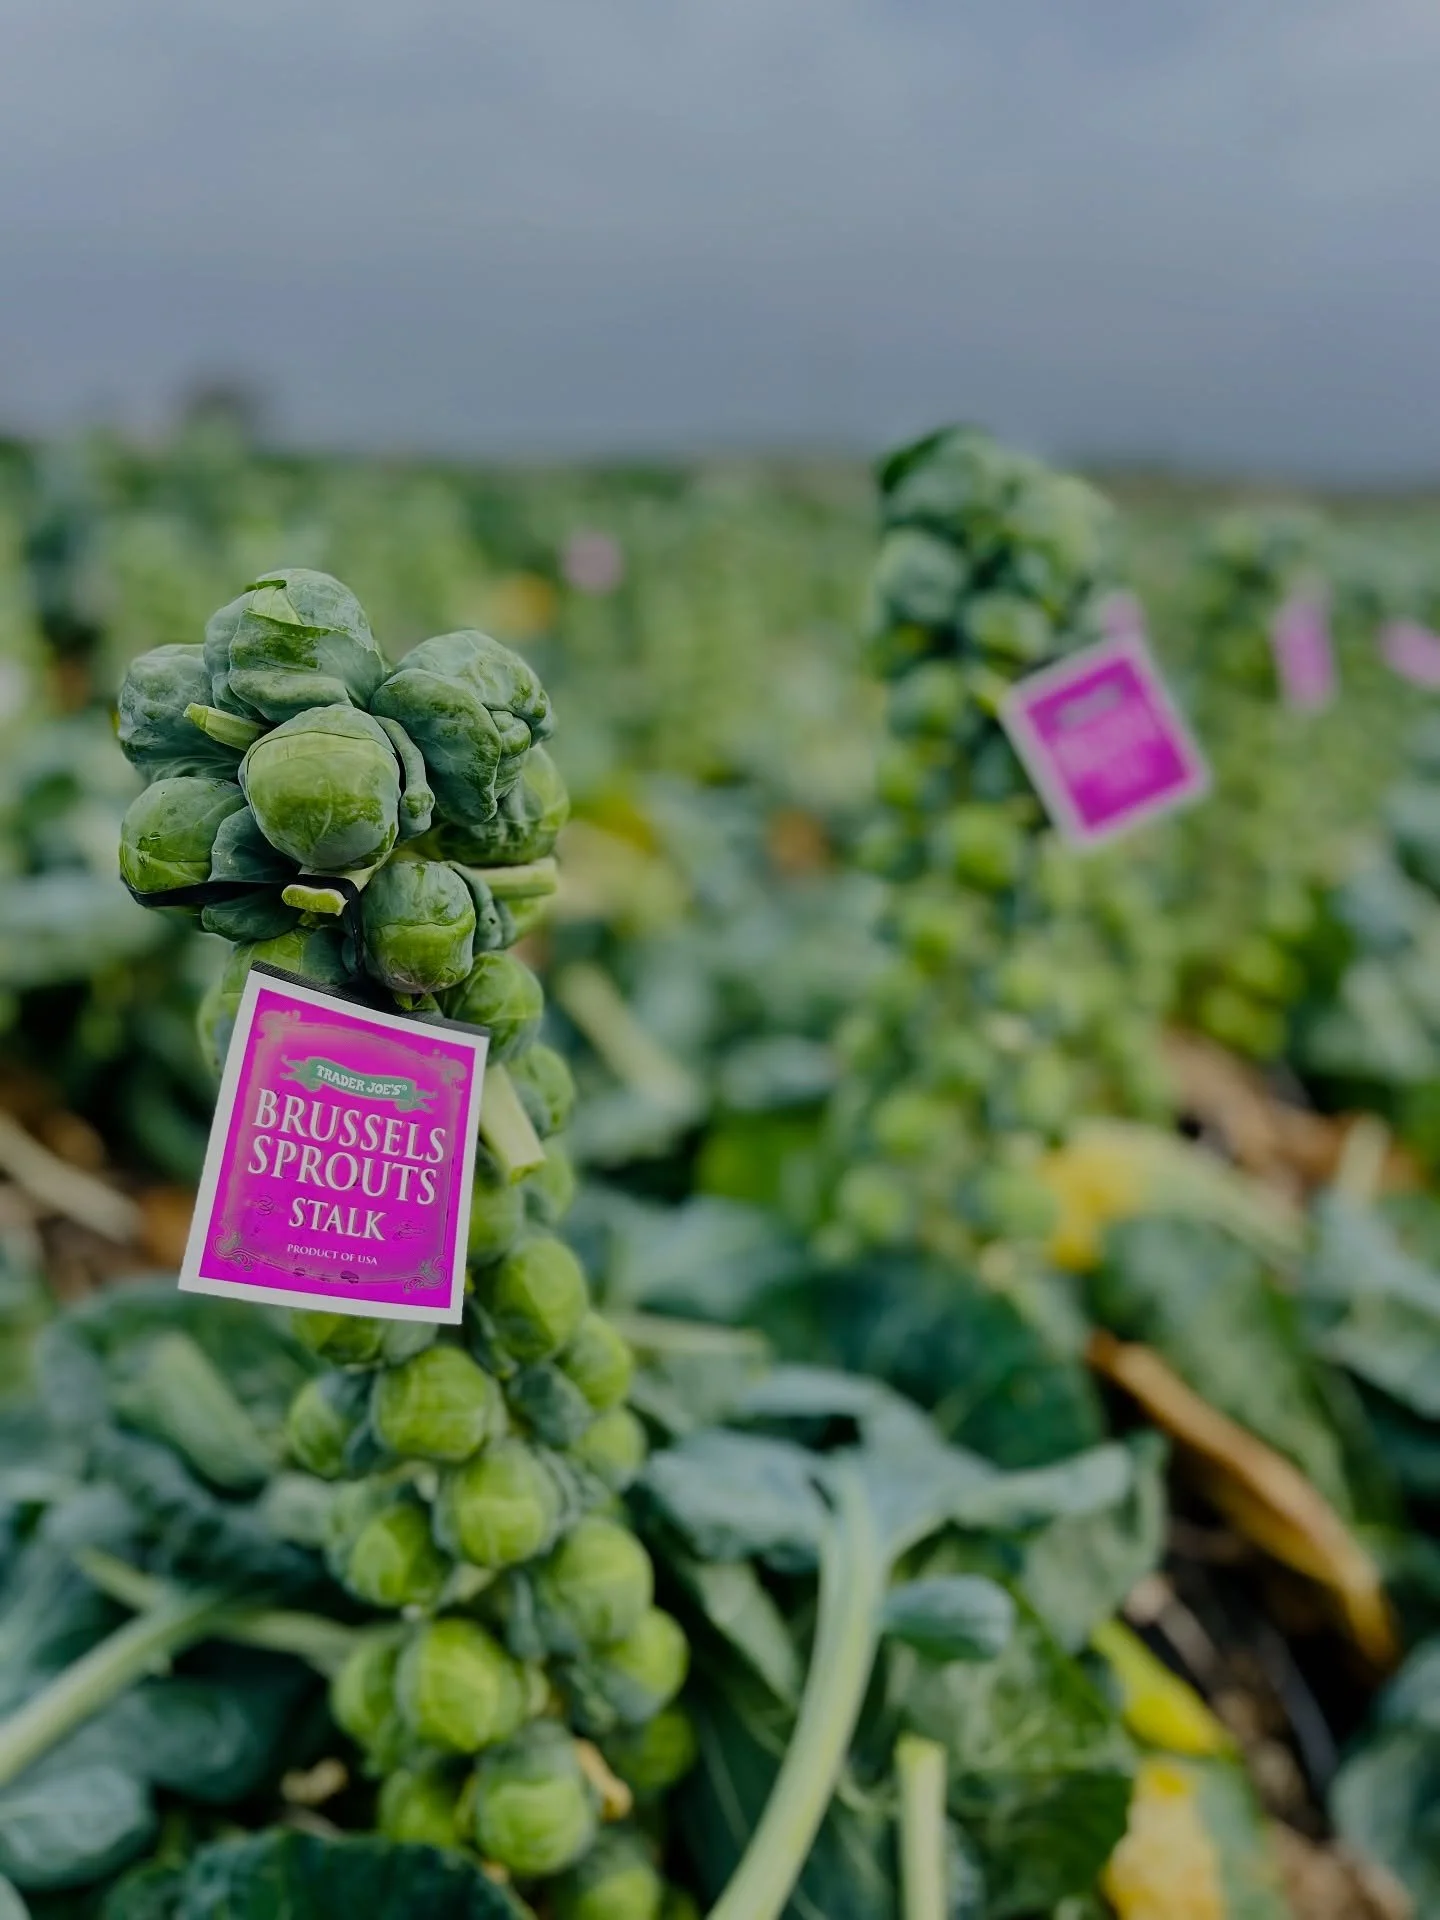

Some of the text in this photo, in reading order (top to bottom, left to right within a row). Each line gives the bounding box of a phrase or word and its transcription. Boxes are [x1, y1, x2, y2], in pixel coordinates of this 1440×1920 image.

[316, 1064, 365, 1091] TRADER
[253, 1088, 446, 1163] BRUSSELS
[247, 1135, 439, 1205] SPROUTS
[288, 1197, 387, 1241] STALK
[286, 1243, 378, 1266] PRODUCT OF USA
